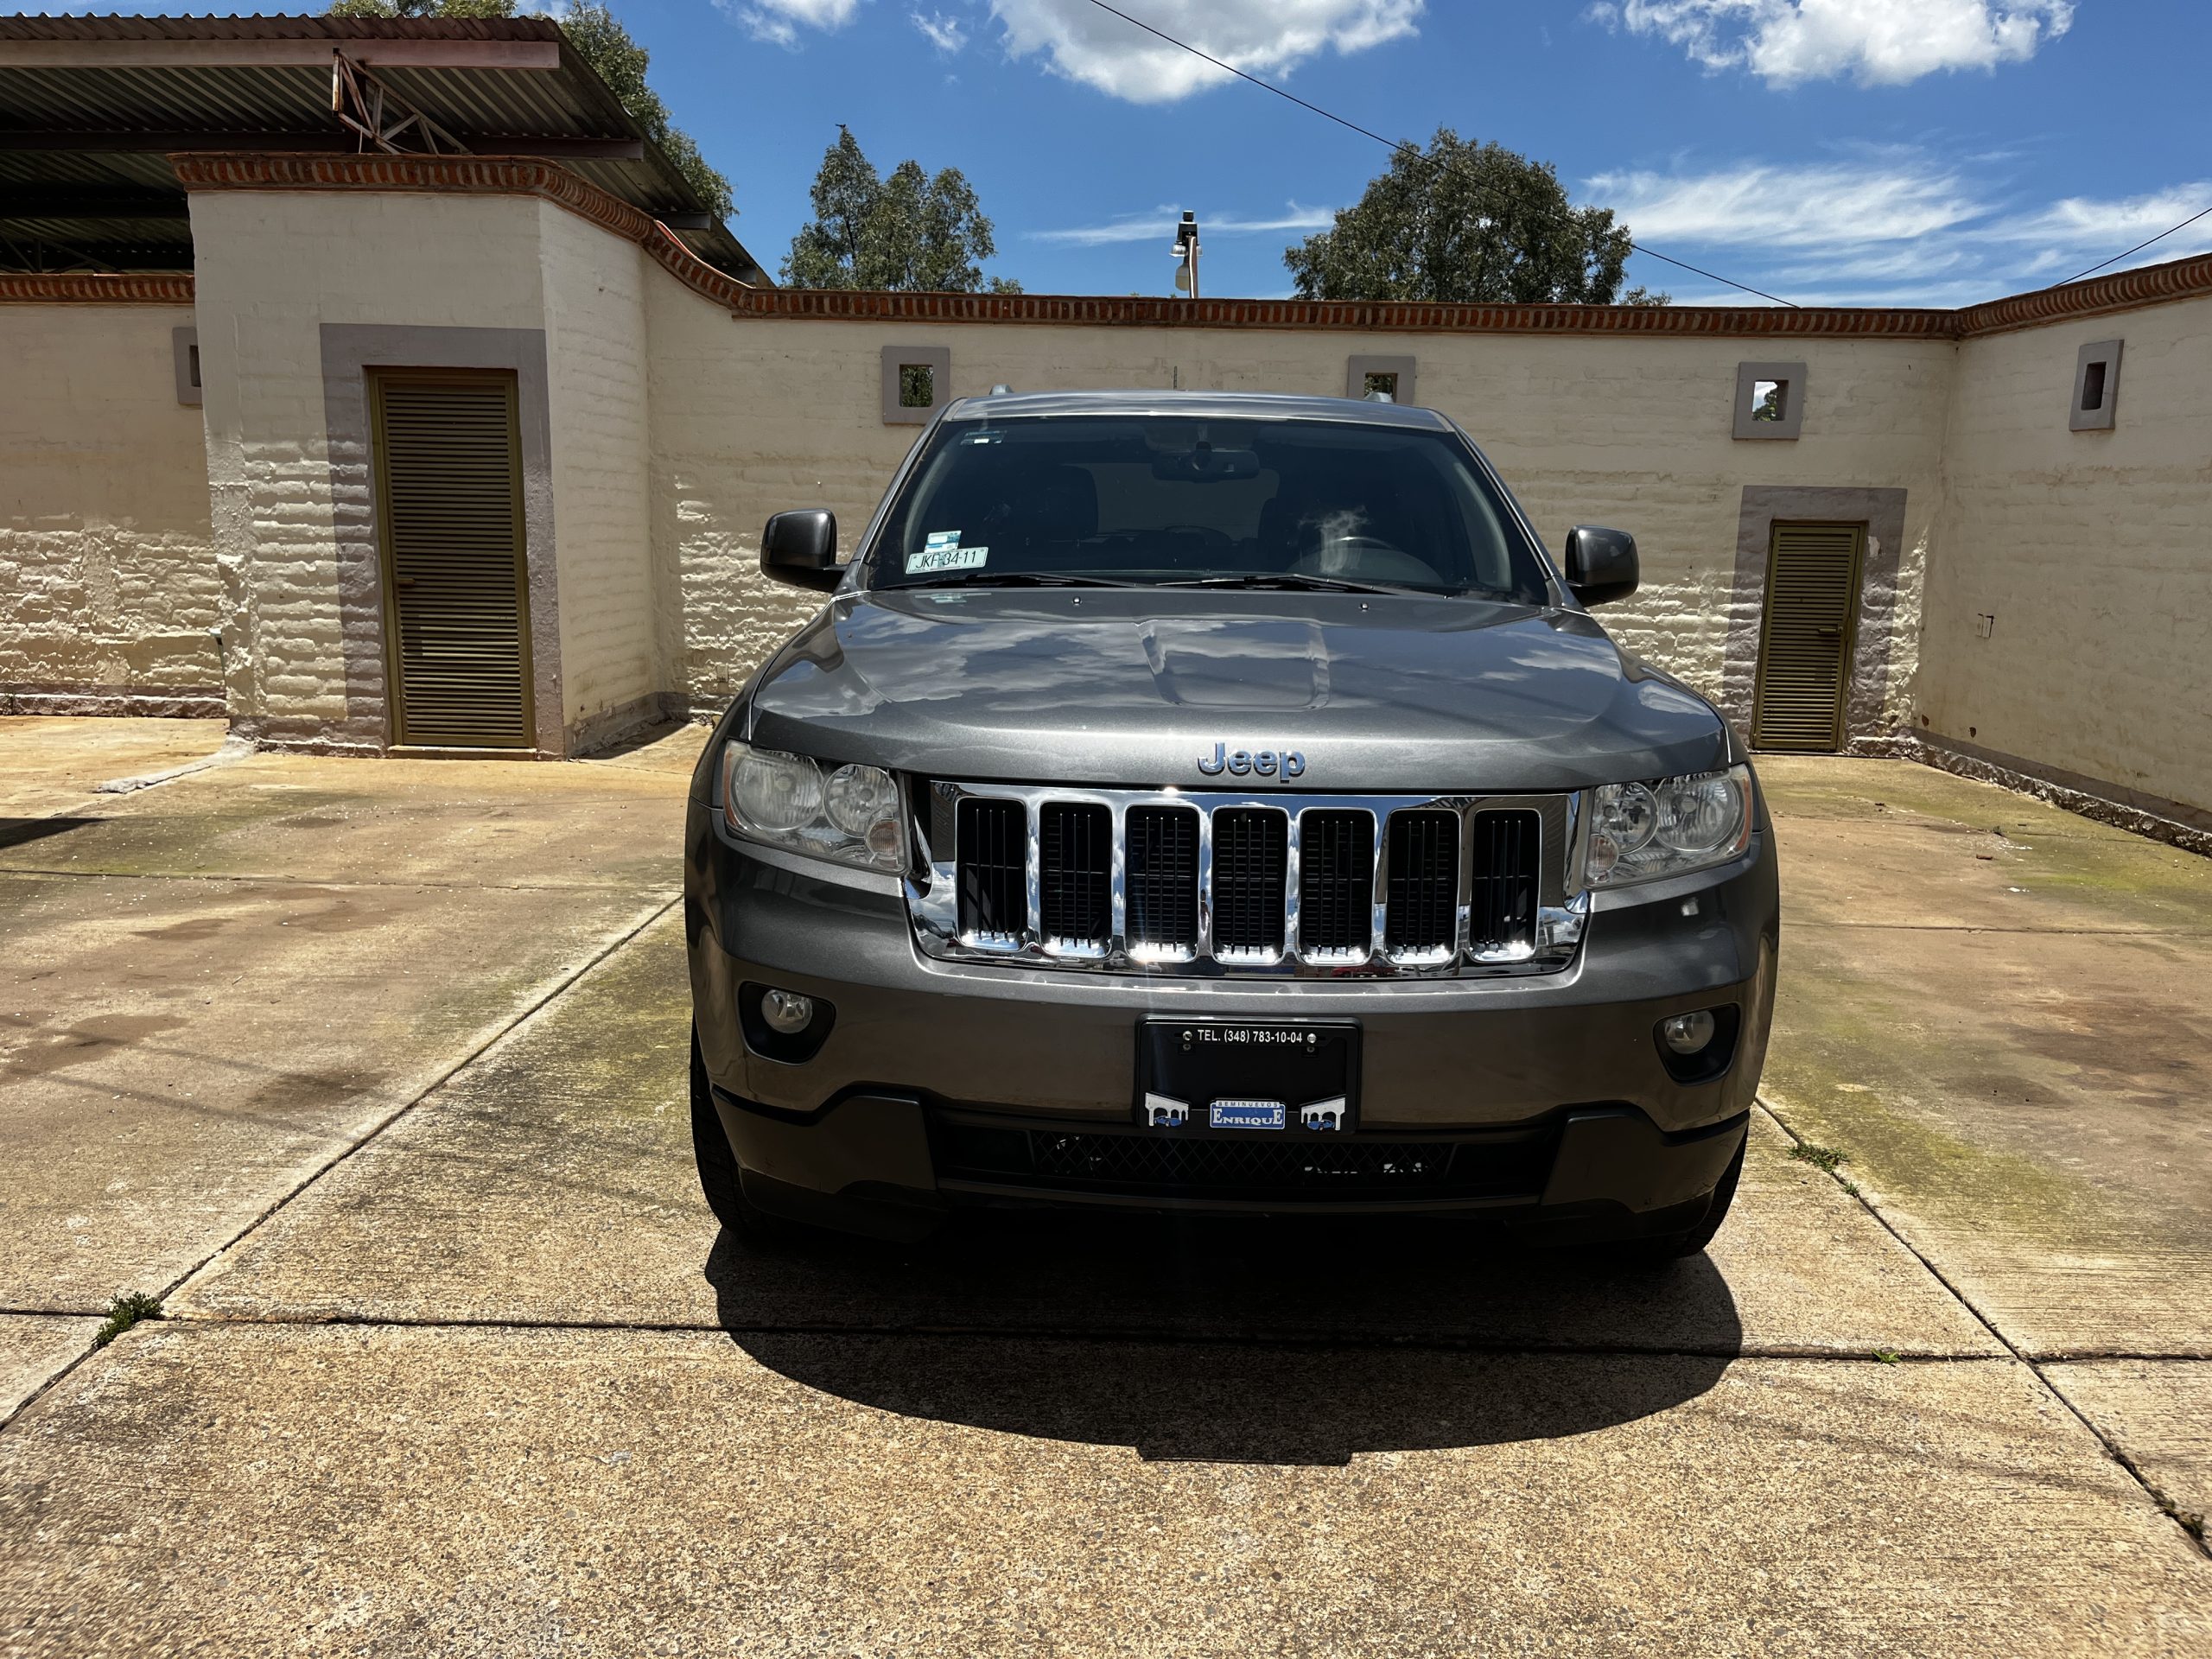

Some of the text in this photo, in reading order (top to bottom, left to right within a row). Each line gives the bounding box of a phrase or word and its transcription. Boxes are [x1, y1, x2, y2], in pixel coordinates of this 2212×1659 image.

[1198, 742, 1306, 784] Jeep
[1198, 1028, 1302, 1043] TEL. (348) 783-10-04
[1212, 1108, 1283, 1126] ENRIQUE
